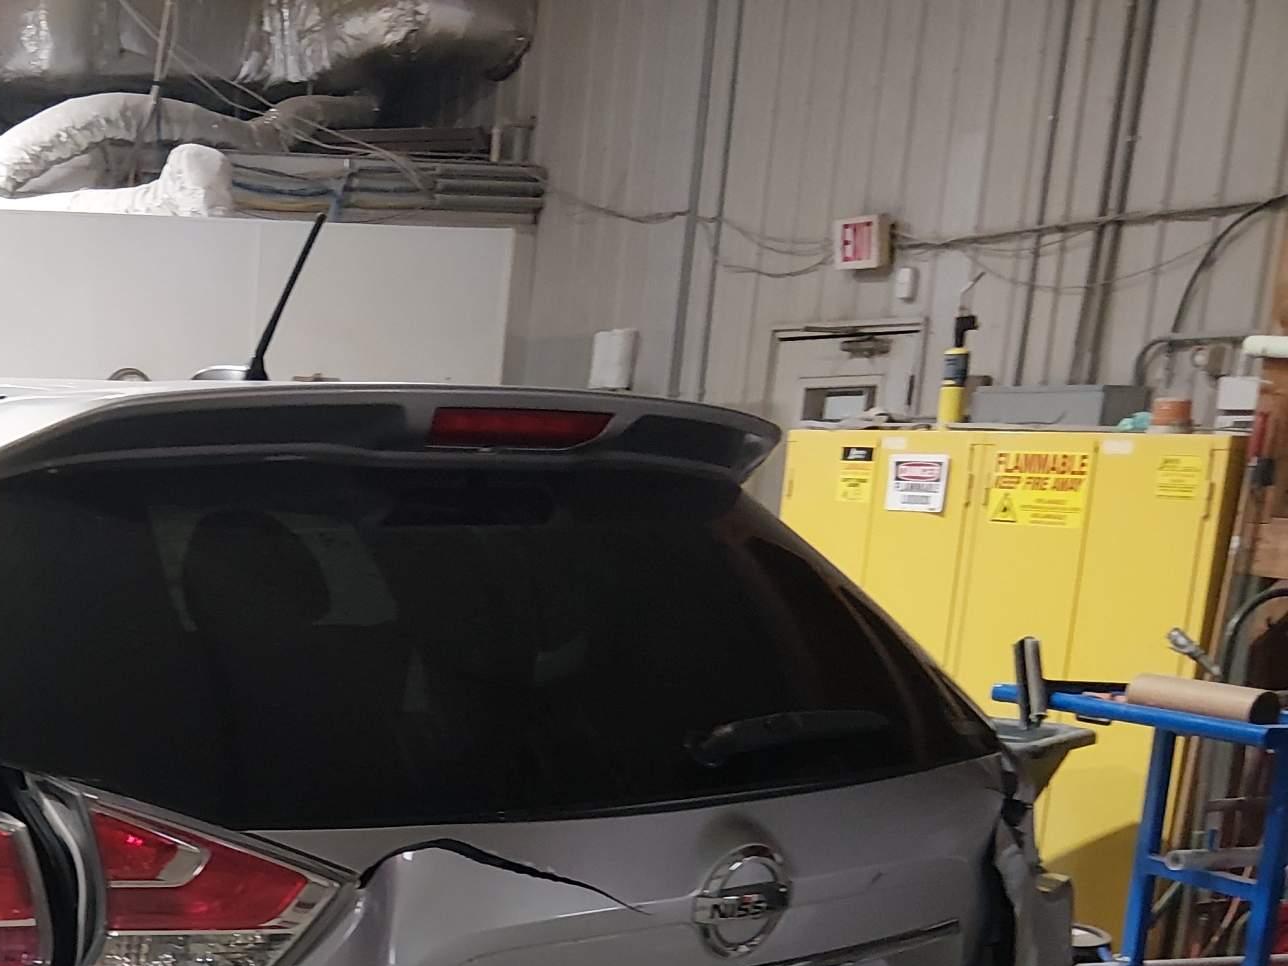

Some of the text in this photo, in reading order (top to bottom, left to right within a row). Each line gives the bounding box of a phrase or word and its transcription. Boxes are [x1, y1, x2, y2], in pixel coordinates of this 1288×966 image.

[842, 221, 873, 262] EXIT
[996, 451, 1088, 476] FLAMMABLE
[994, 474, 1085, 492] KEEP FIRE AWAY
